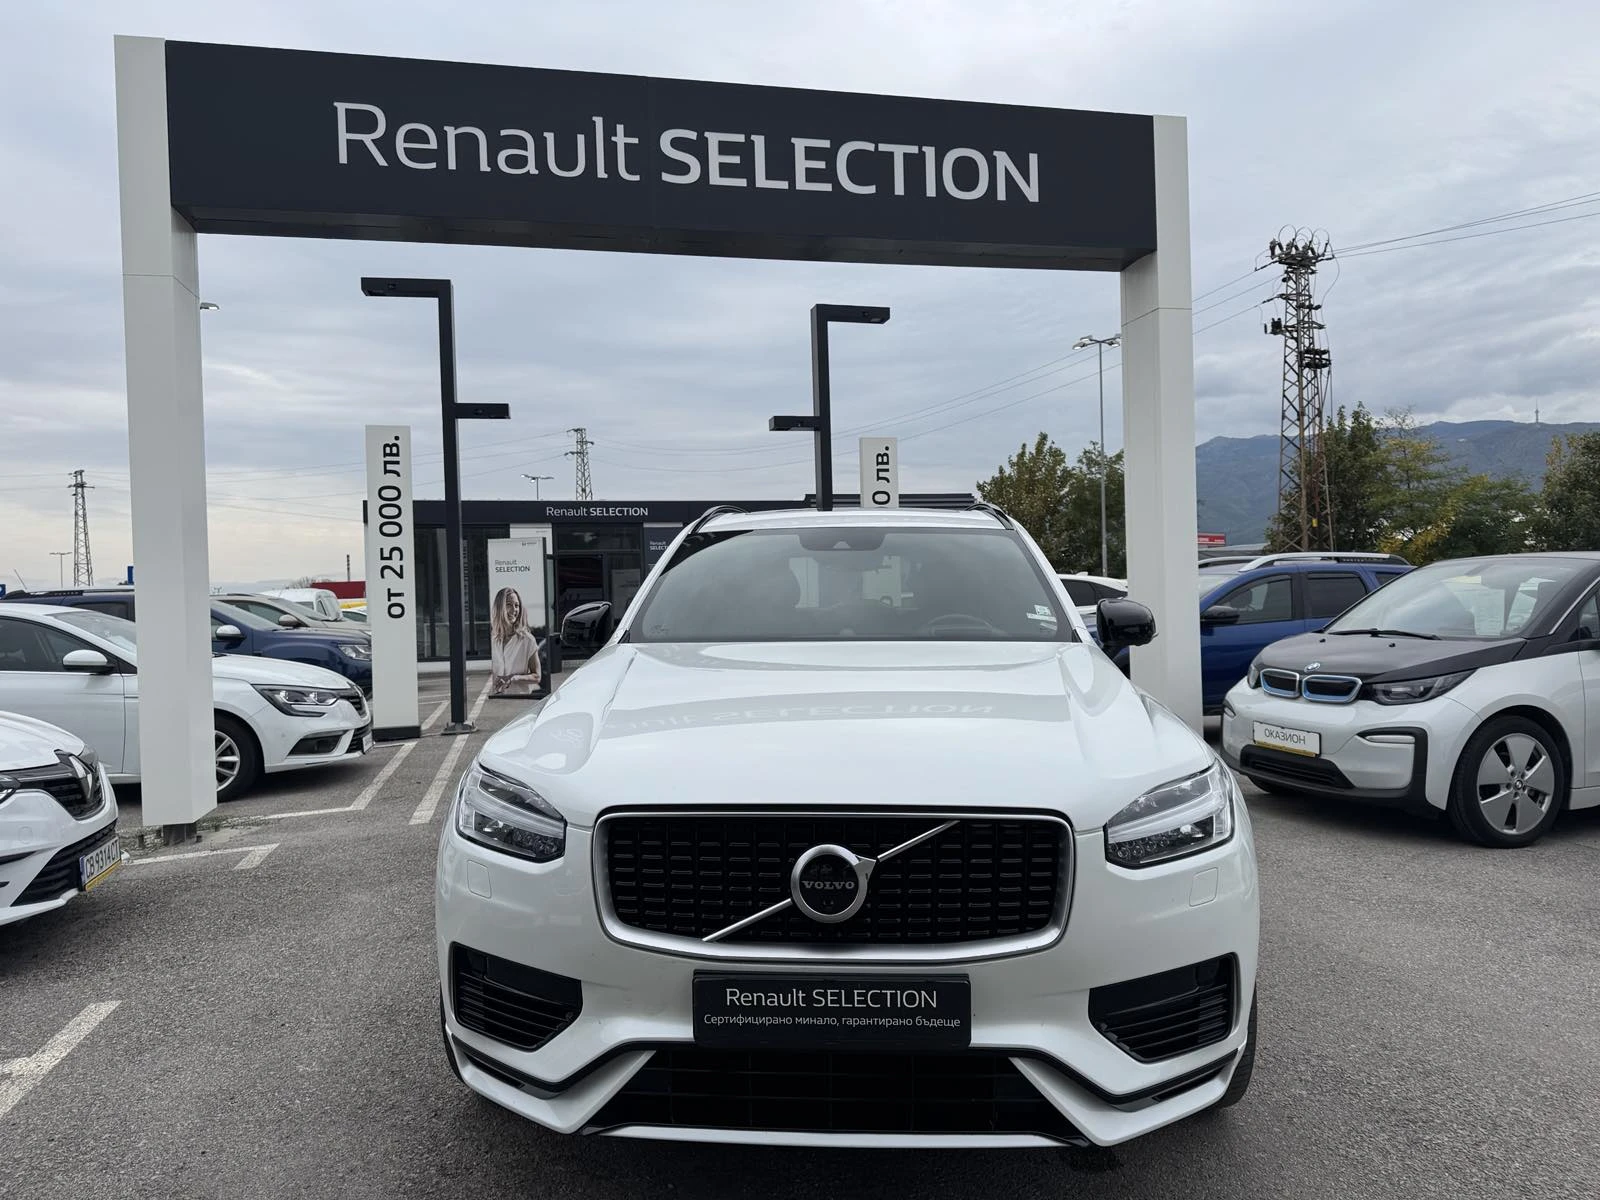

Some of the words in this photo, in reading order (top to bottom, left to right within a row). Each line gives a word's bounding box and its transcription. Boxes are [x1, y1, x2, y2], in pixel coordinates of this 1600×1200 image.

[334, 101, 641, 182] Renault
[660, 128, 1040, 203] SELECTION
[382, 435, 401, 478] лв.
[875, 445, 891, 484] лв.
[871, 490, 891, 509] 0
[377, 485, 403, 538] 000
[546, 506, 588, 517] Renault
[589, 507, 649, 517] SELECTION
[379, 546, 404, 580] 25
[495, 565, 531, 573] SELECTION
[1264, 727, 1306, 745] ОКАЗИОН
[801, 880, 855, 890] VOLVO
[726, 988, 807, 1007] Renault
[812, 989, 937, 1008] SELECTION
[703, 1013, 793, 1027] Сертифицирано
[795, 1016, 840, 1027] минало,
[841, 1017, 913, 1028] гарантирано
[915, 1015, 961, 1028] бъдеще
